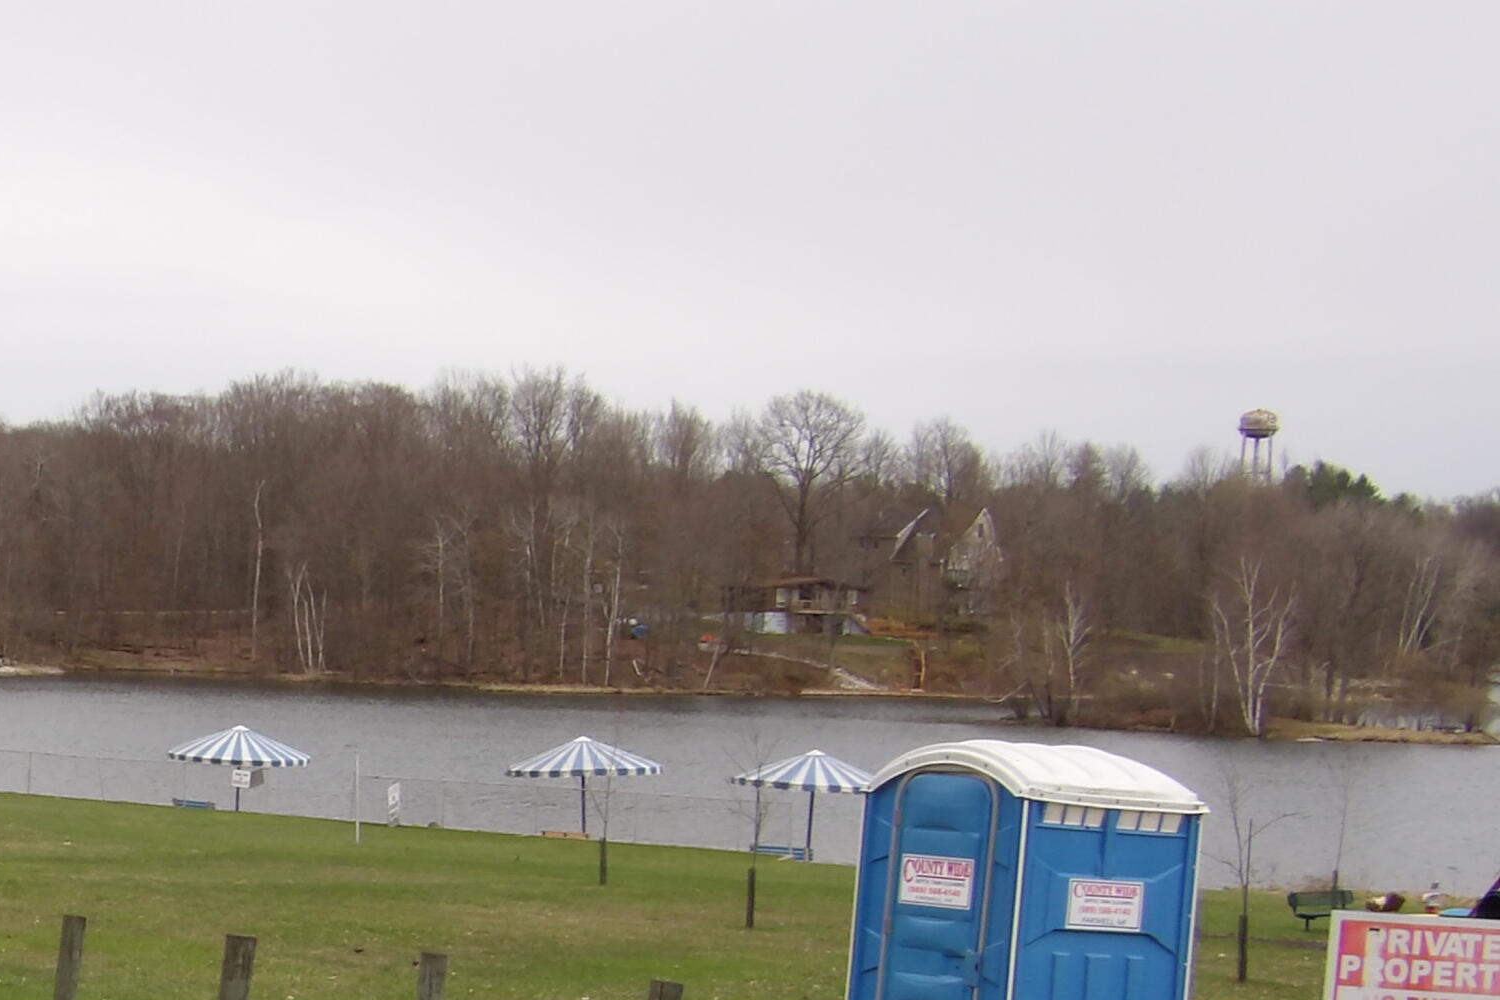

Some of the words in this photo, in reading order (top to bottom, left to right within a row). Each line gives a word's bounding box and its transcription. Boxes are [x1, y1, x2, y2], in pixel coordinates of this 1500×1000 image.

[903, 859, 945, 883] COUNTY
[947, 862, 971, 878] WIDE
[1074, 883, 1112, 897] COUNTY
[1115, 886, 1138, 897] WIDE
[1365, 927, 1500, 961] PRIVATE
[1339, 954, 1499, 990] PROPERT
